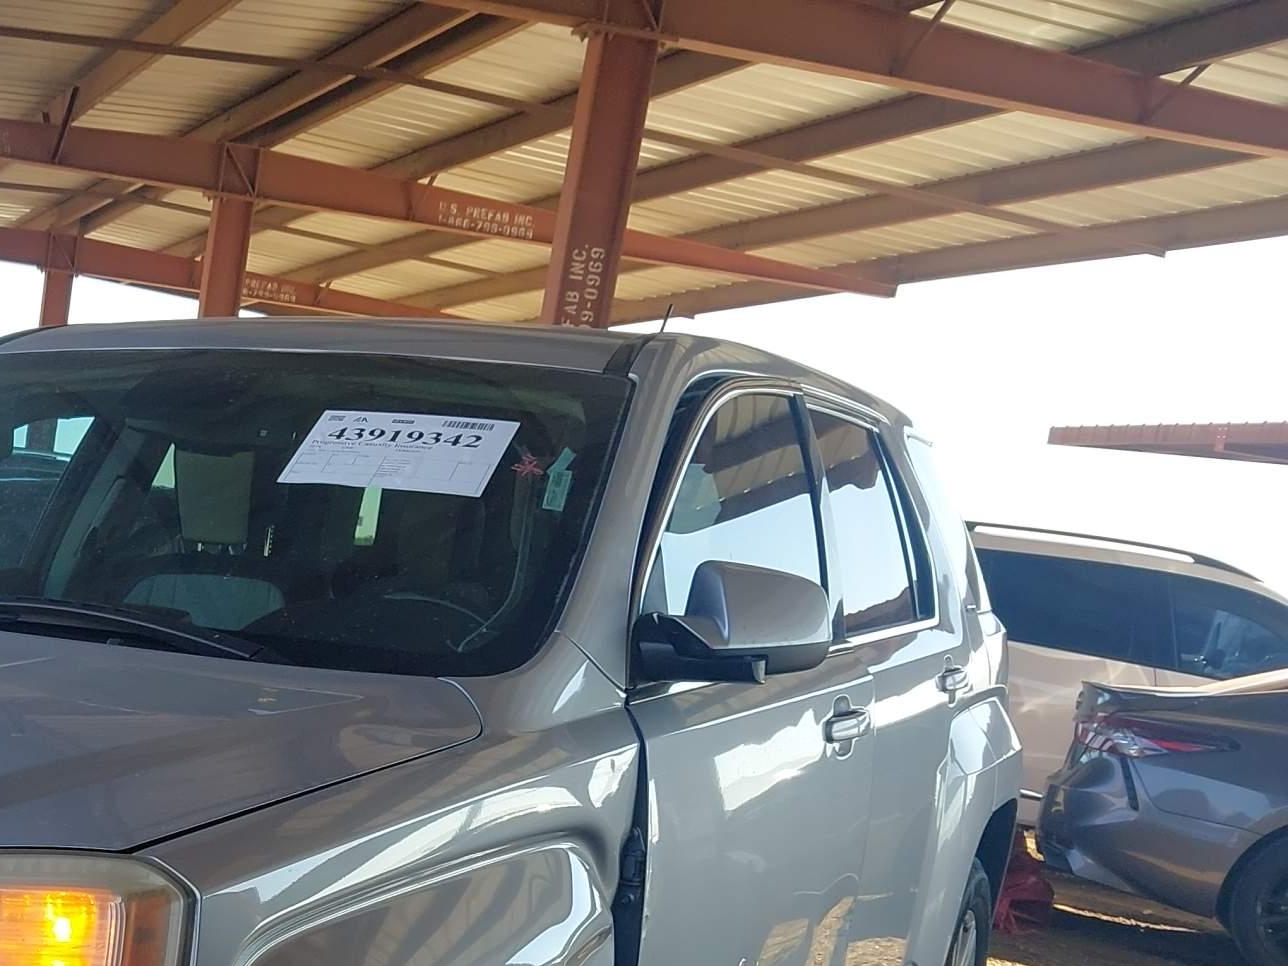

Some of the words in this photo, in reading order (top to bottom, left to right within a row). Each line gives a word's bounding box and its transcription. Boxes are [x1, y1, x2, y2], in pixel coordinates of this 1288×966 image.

[466, 206, 510, 223] PREFAB
[569, 244, 588, 280] INC.
[328, 426, 483, 449] 43919342
